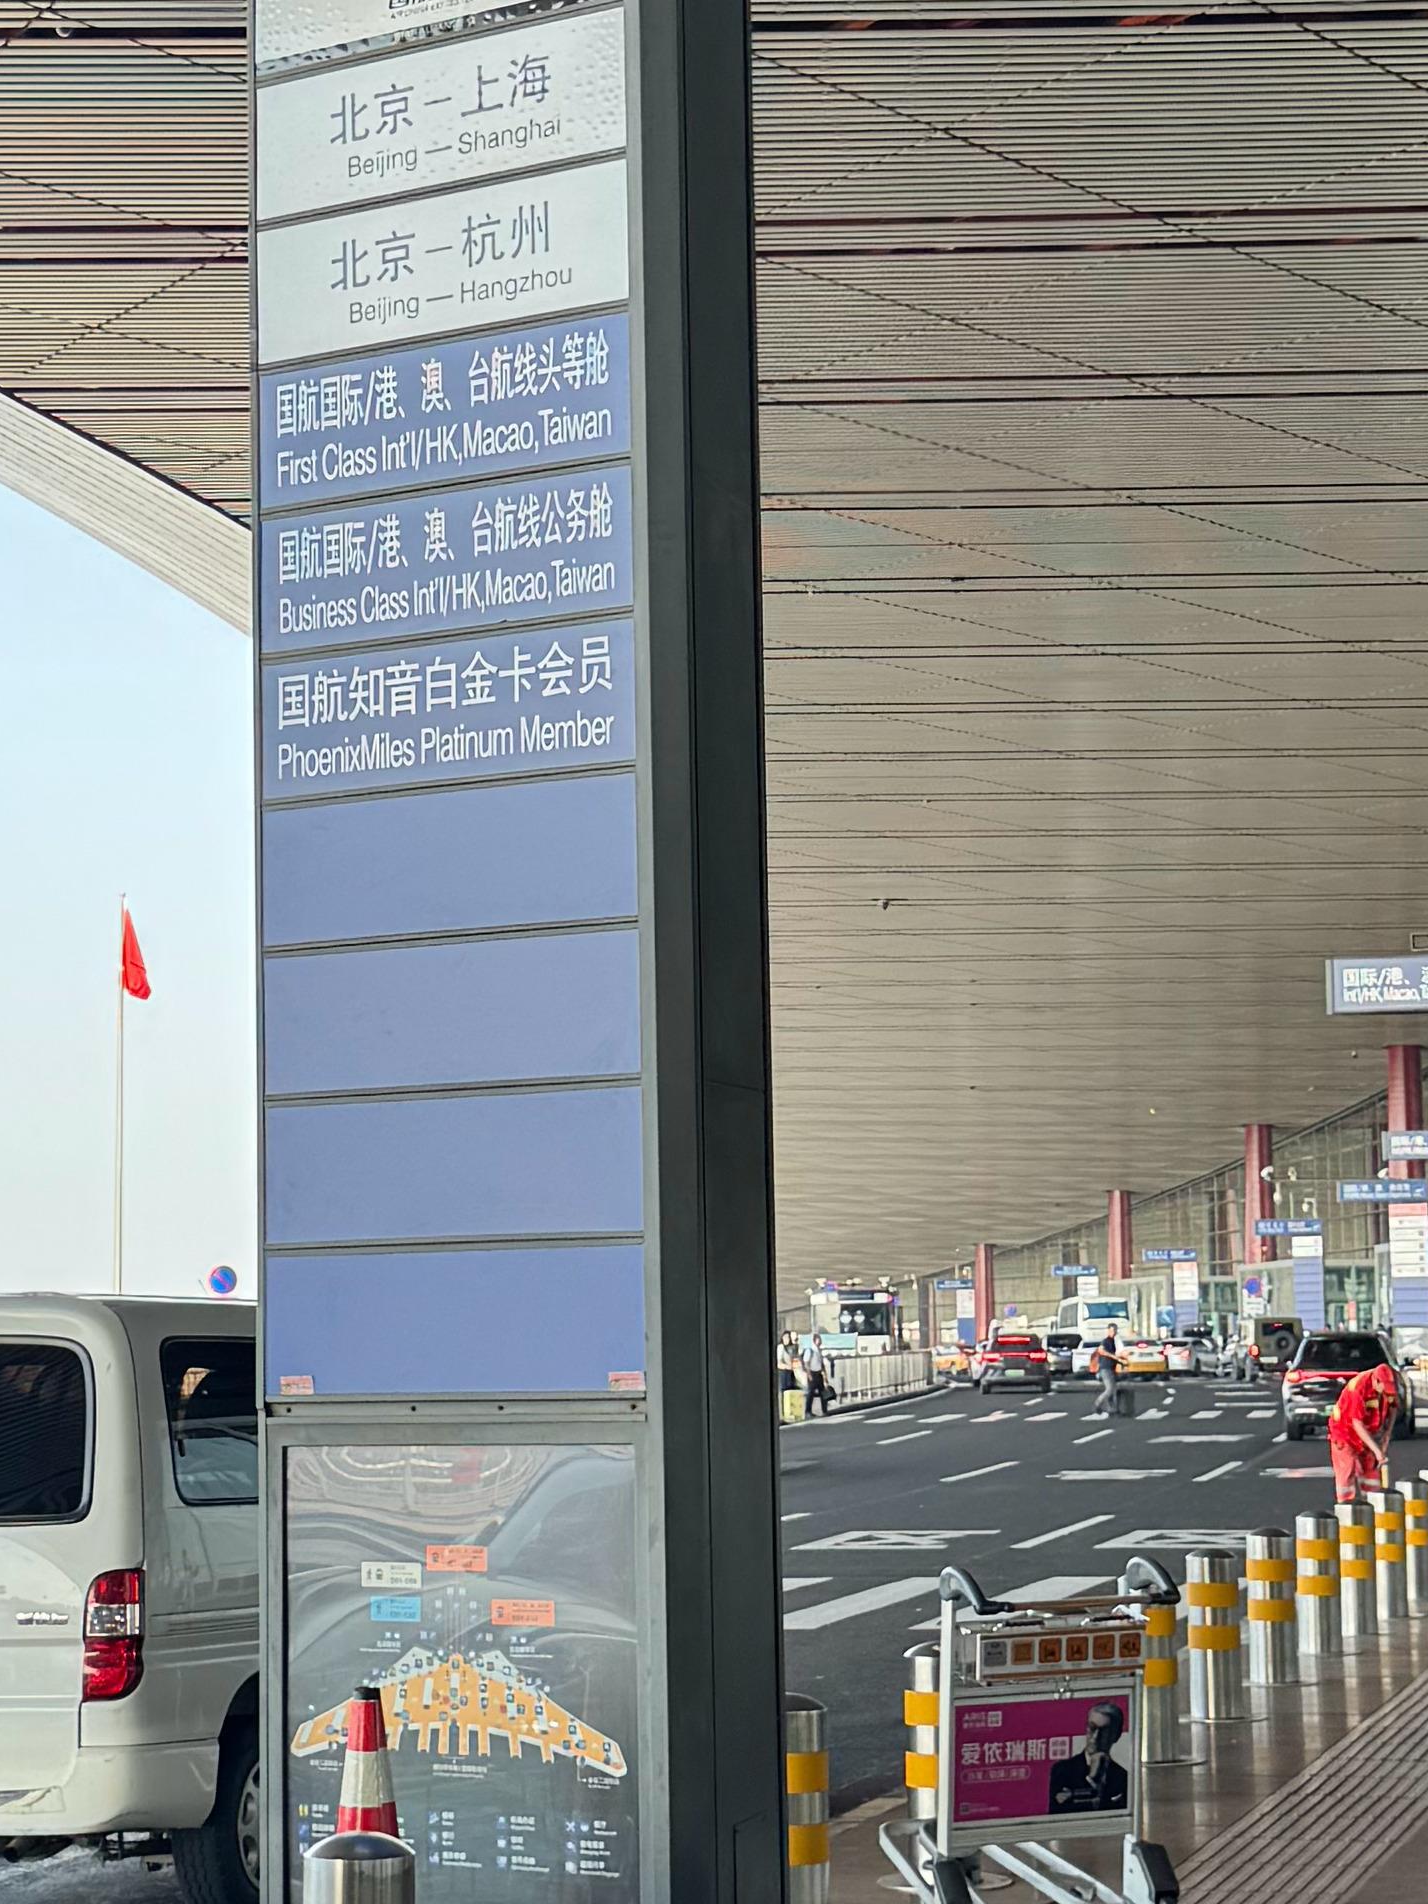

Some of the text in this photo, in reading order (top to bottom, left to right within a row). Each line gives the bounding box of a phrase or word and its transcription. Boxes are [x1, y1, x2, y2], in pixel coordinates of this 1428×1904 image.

[347, 144, 418, 178] Beijing
[458, 117, 561, 155] Shanghai
[349, 290, 420, 324] Beijing
[460, 266, 572, 304] Hangzhou
[277, 448, 318, 487] First
[322, 443, 377, 481] Class
[279, 592, 357, 634] Business
[360, 585, 409, 624] Class
[277, 634, 613, 731] 国航知音白金卡会员
[278, 711, 614, 780] PhoenixMiles Platinum Member
[961, 1738, 1046, 1765] 爱依瑞斯
